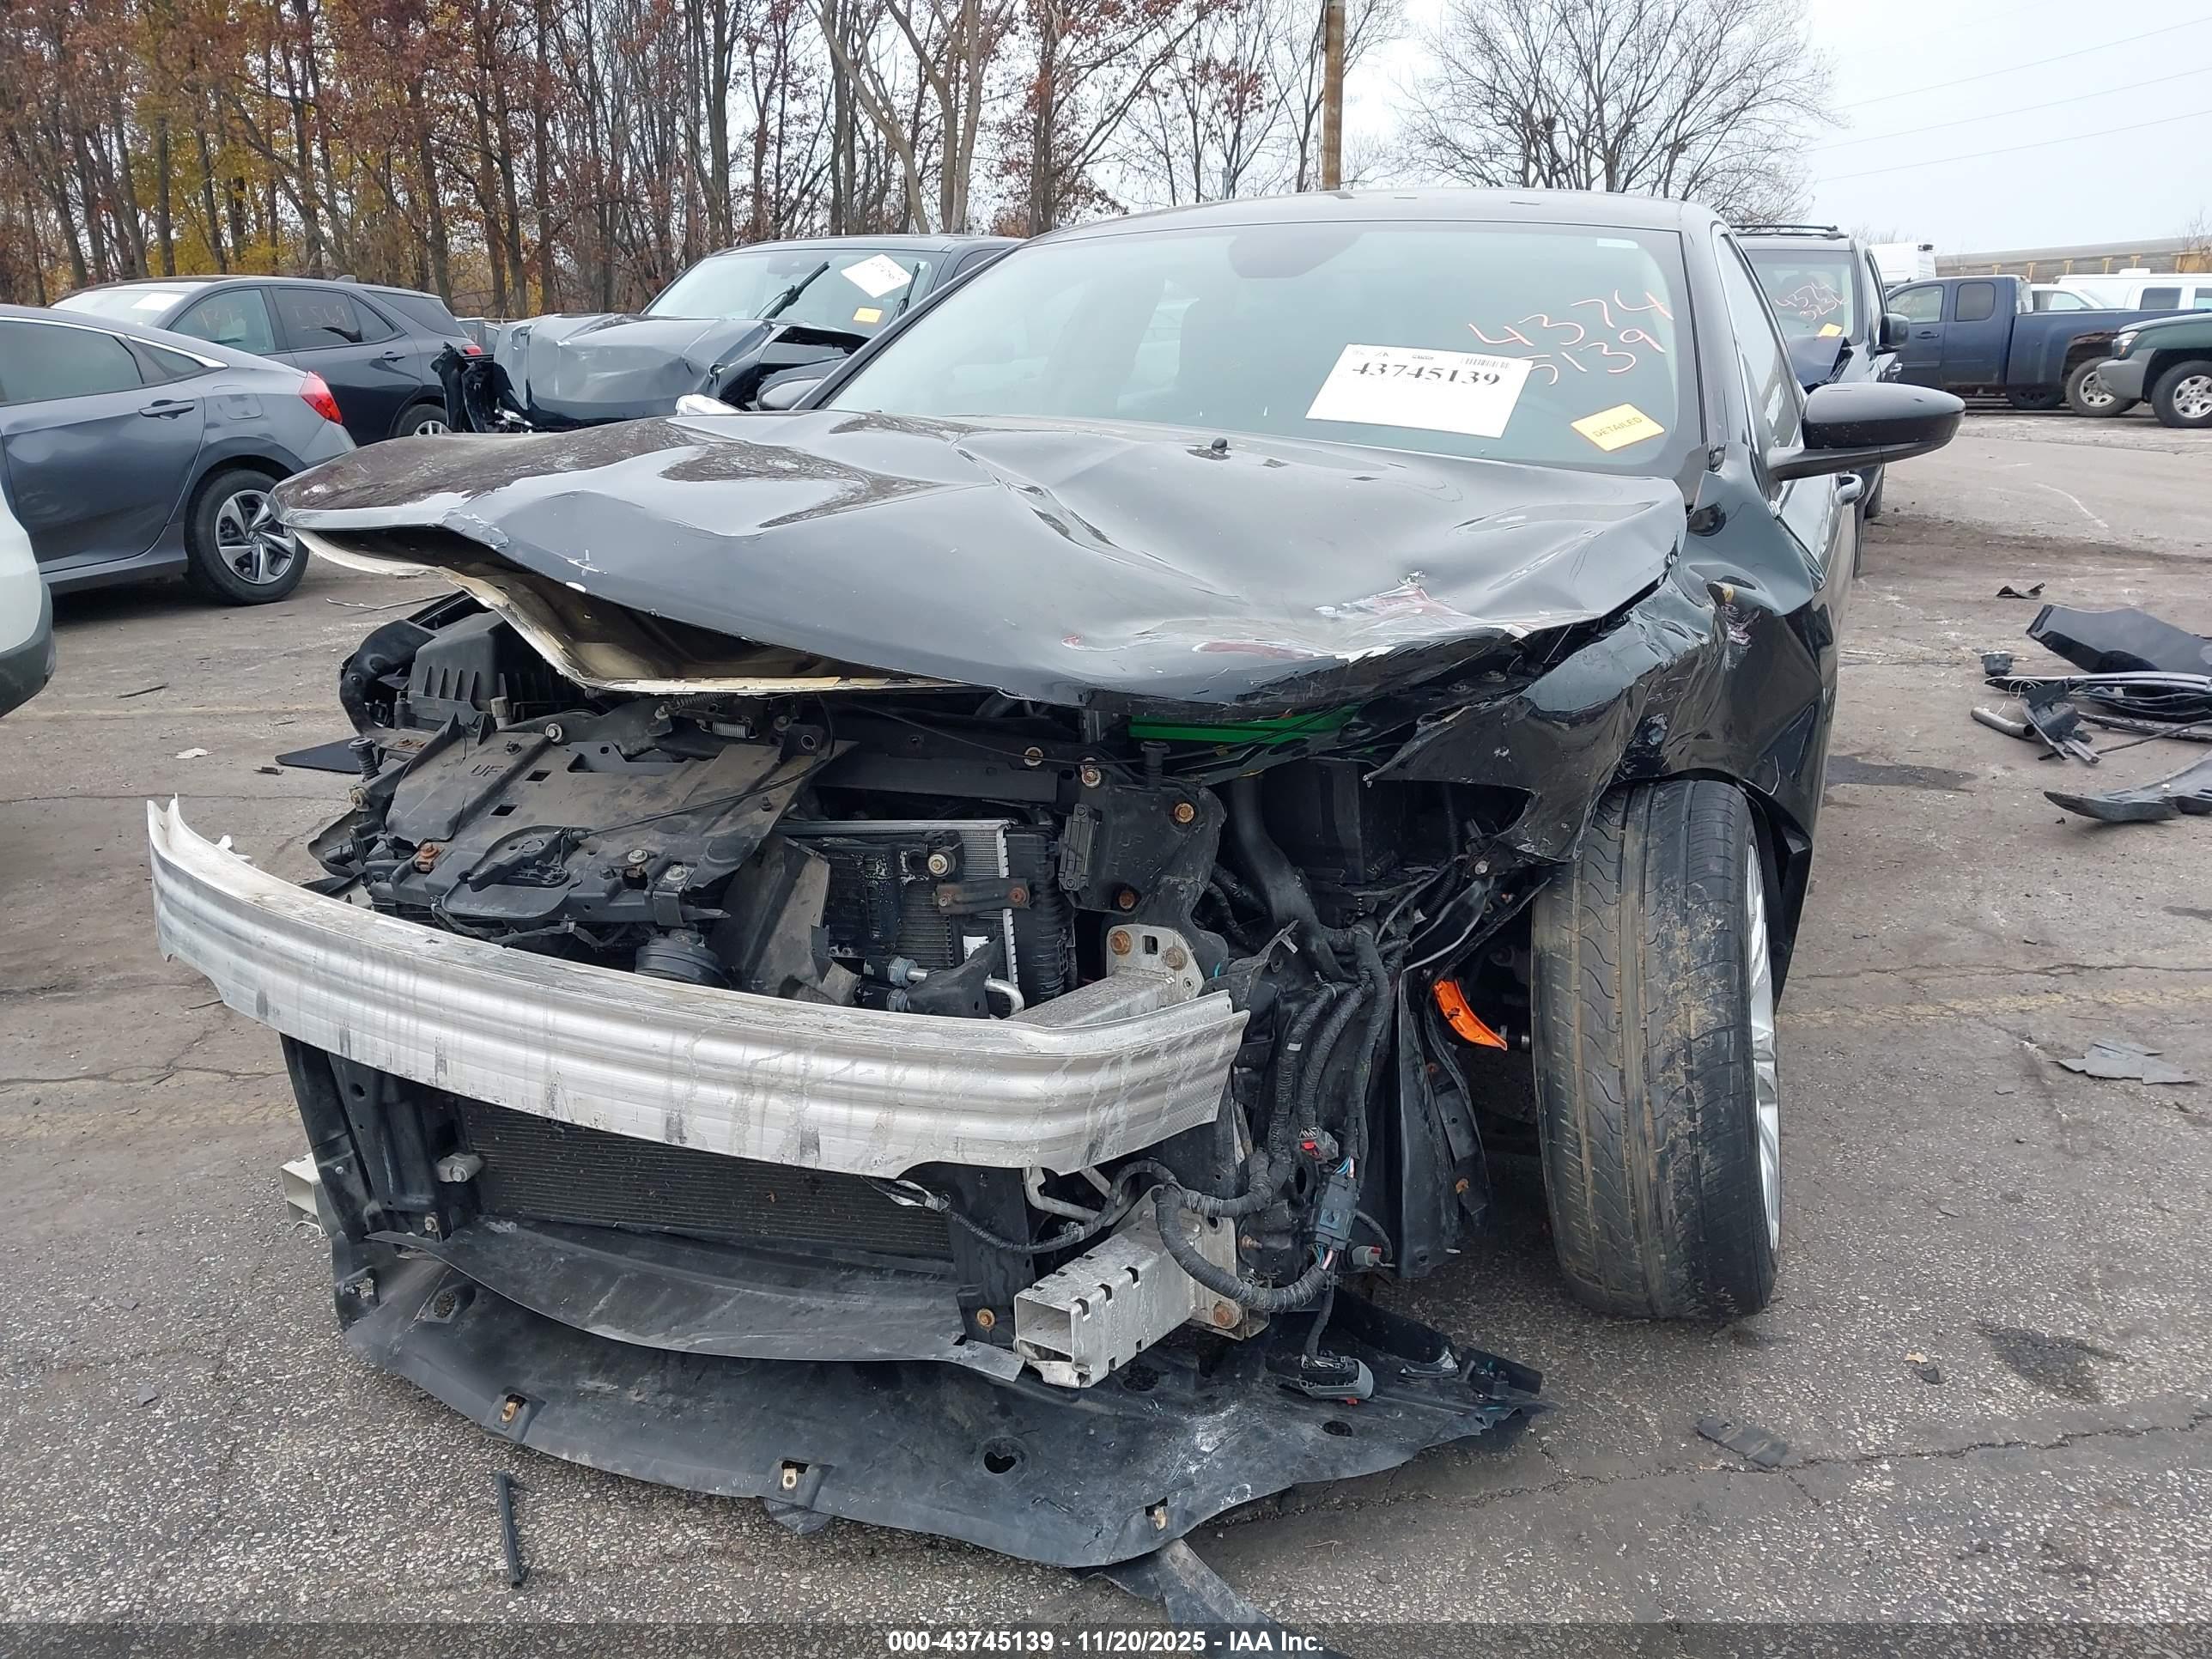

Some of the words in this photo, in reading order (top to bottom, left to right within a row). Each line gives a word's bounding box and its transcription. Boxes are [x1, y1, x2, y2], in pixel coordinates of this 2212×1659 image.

[1468, 289, 1675, 348] 4374
[1352, 362, 1501, 386] 43745139
[1593, 416, 1644, 438] DETAILED
